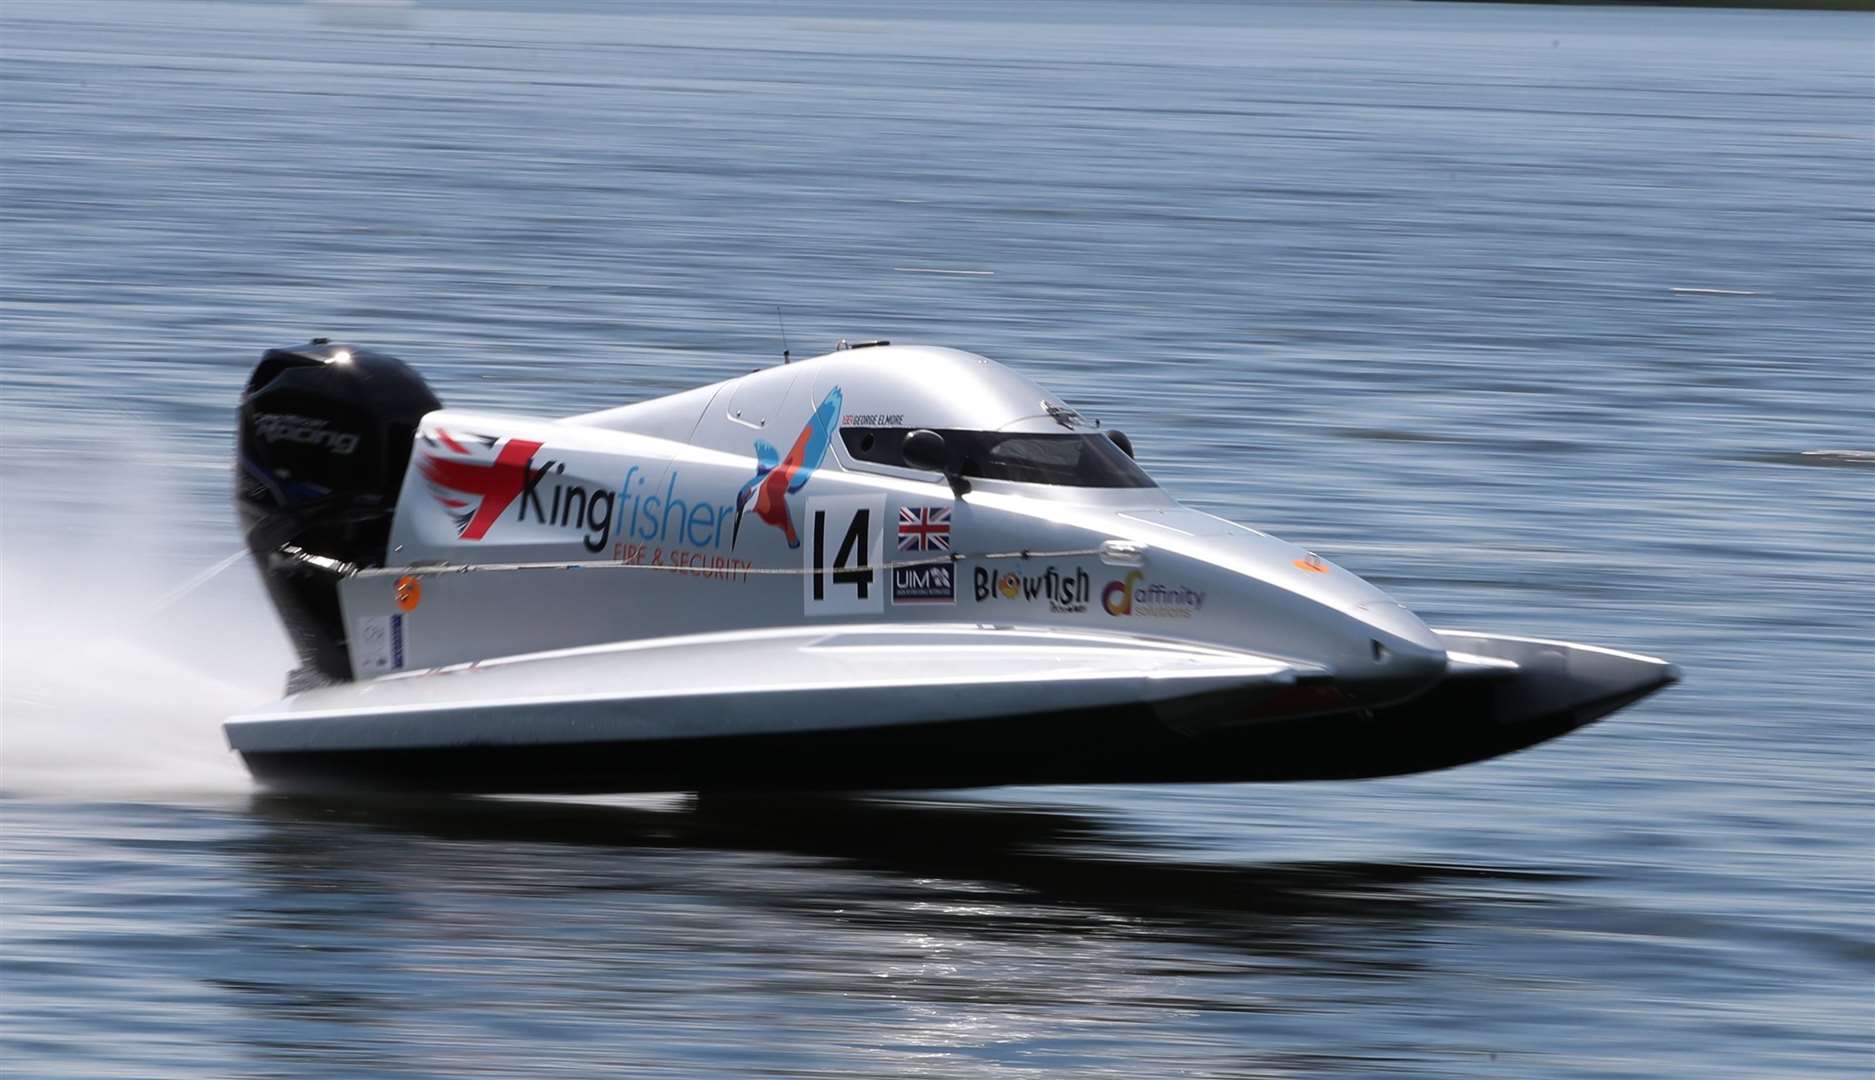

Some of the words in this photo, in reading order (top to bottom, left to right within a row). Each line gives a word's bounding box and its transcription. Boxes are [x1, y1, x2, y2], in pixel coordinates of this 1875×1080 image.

[853, 414, 877, 426] GEORGE
[878, 413, 904, 426] ELMORE
[517, 459, 735, 553] Kingfisher
[612, 542, 647, 568] FIRE
[651, 548, 665, 572] &
[669, 549, 753, 584] SECURITY
[813, 508, 874, 601] 14
[896, 569, 930, 589] UIM
[974, 565, 1090, 606] Blowfish
[1135, 583, 1207, 611] affinity
